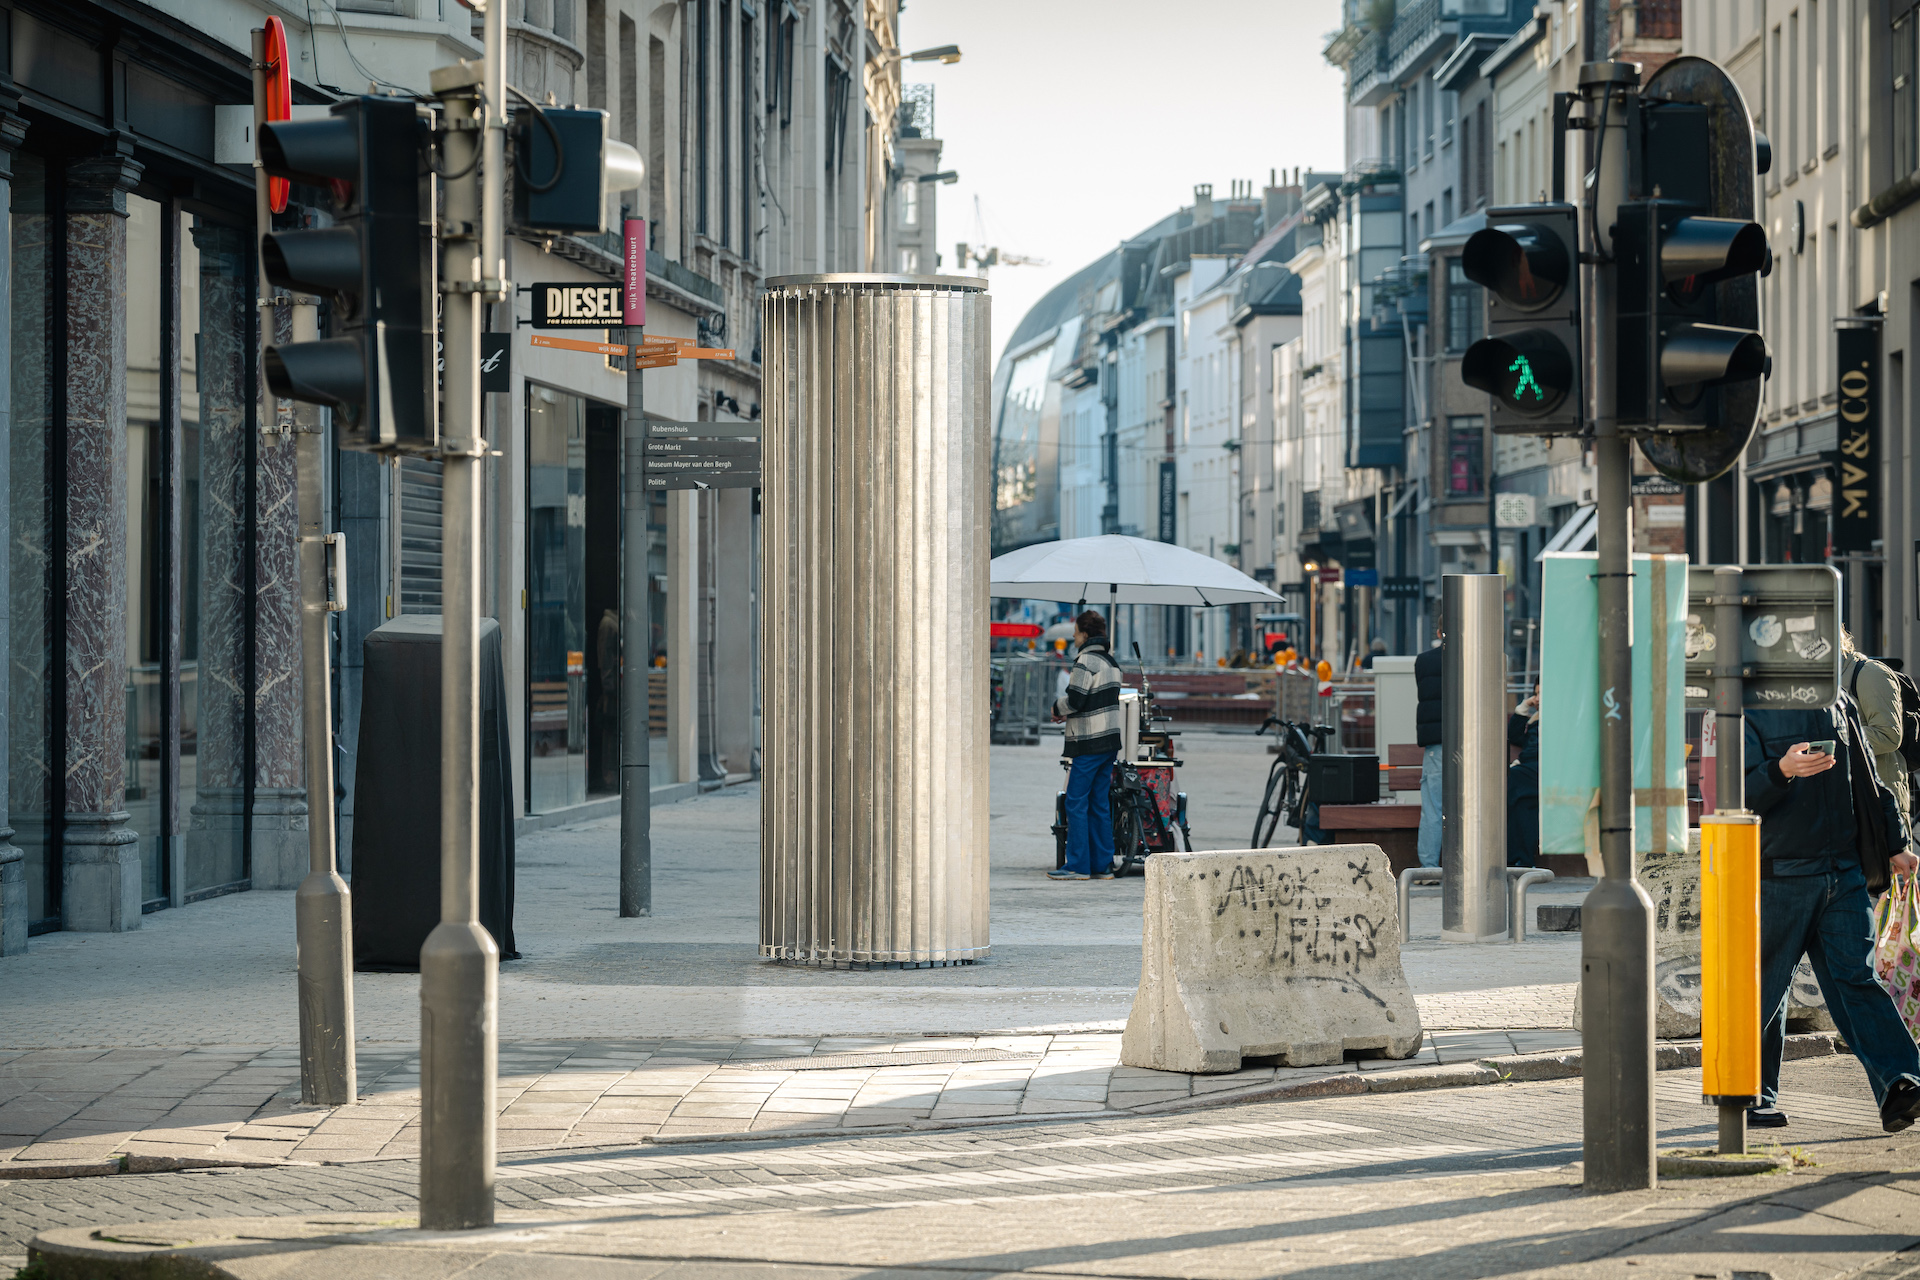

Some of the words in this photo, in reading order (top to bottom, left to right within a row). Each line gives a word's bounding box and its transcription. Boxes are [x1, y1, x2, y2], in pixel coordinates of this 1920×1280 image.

[629, 236, 637, 291] Theaterbuurt
[546, 287, 623, 318] DIESEL
[629, 292, 638, 310] wijk
[652, 425, 688, 433] Rubenshuis
[648, 443, 664, 451] Grote
[665, 443, 681, 451] Markt
[673, 461, 691, 469] Mayer
[714, 461, 732, 469] Bergh
